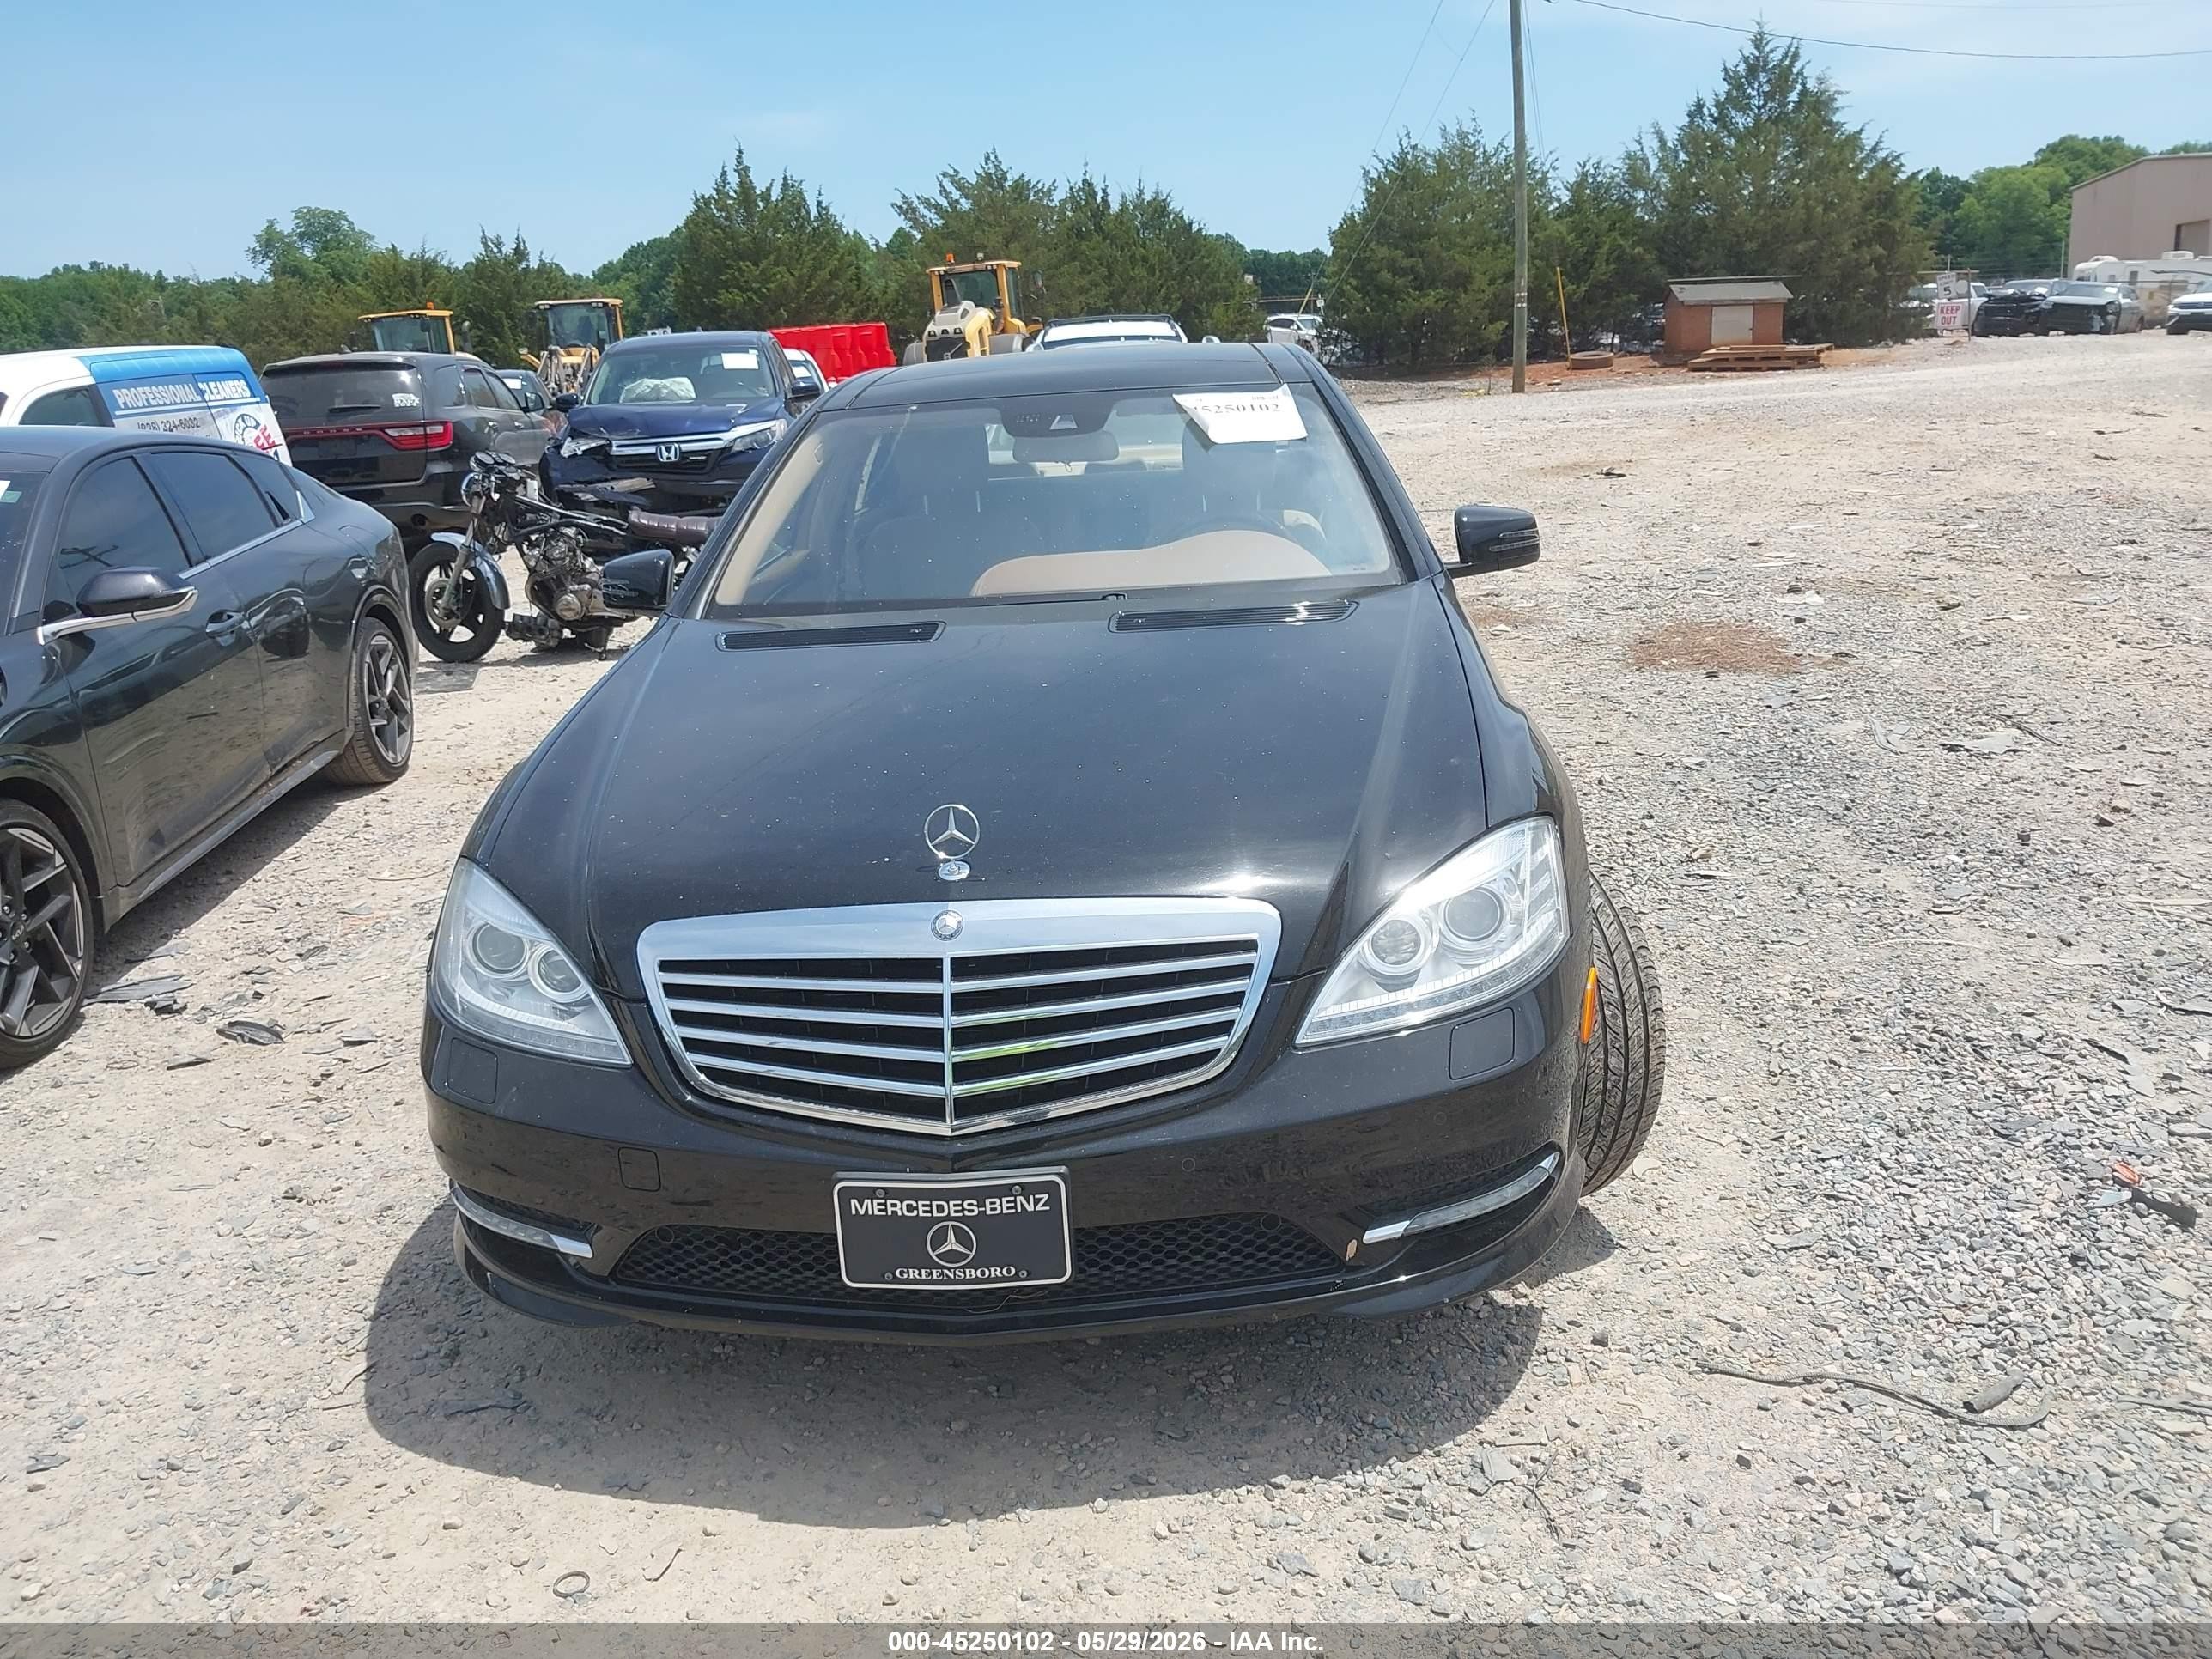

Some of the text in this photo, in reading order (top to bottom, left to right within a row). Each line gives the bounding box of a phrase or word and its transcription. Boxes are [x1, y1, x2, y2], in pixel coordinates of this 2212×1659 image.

[1943, 285, 1952, 296] 5
[1940, 306, 1960, 314] KEEP
[1942, 316, 1957, 325] OUT
[112, 379, 251, 409] PROFESSIONAL CLEANERS
[161, 417, 201, 432] 324-6032
[850, 1194, 1050, 1217] MERCEDES-BENZ
[895, 1266, 1016, 1280] GREENSBORO
